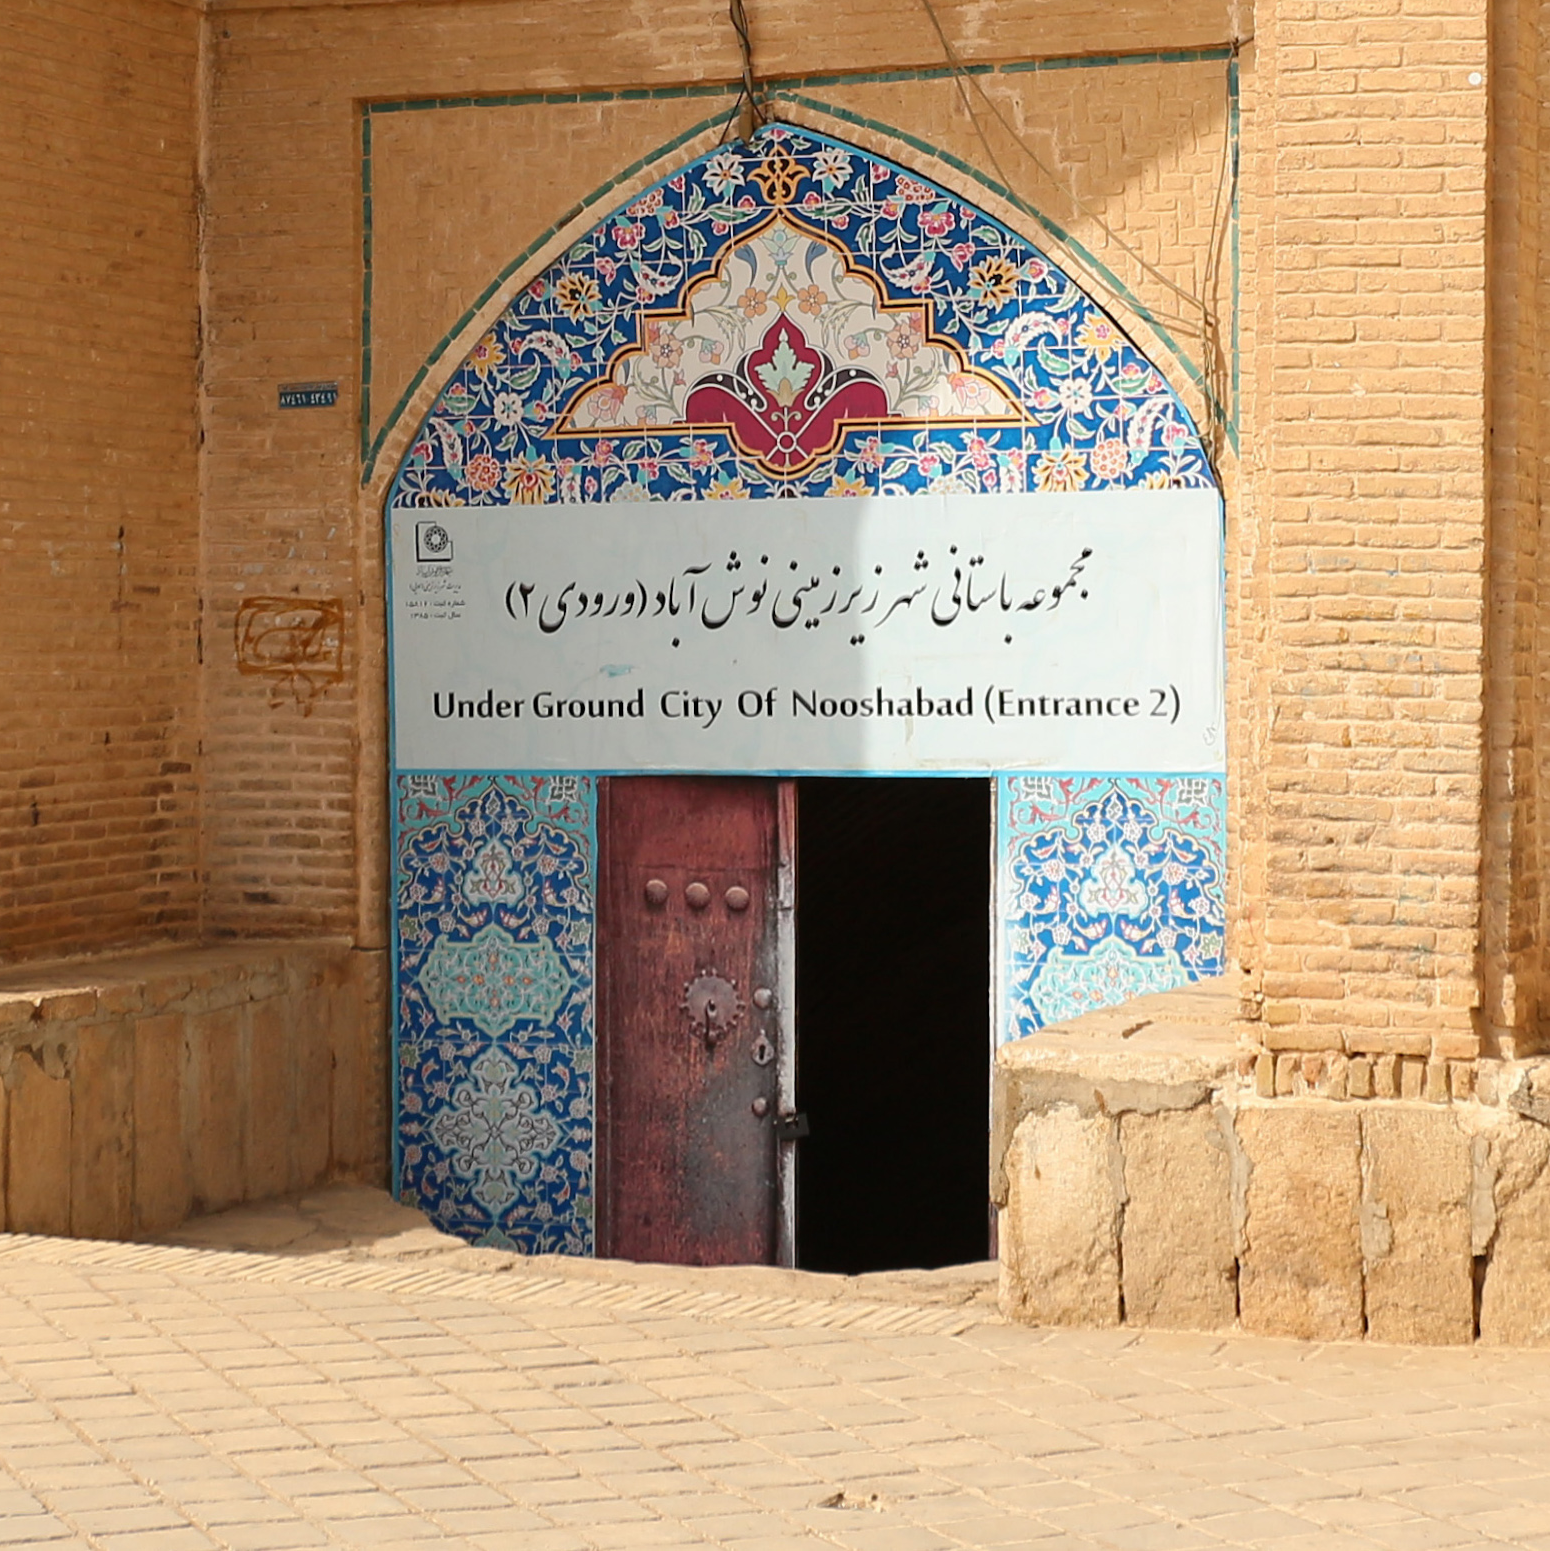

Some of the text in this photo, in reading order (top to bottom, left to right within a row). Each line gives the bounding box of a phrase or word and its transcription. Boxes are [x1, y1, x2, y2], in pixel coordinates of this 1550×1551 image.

[505, 580, 536, 620] ۲)
[538, 579, 648, 634] (ورودی
[652, 562, 713, 648] آباد
[701, 550, 769, 629] نوش
[874, 550, 929, 629] شهر
[931, 545, 1013, 645] باستانی
[1015, 547, 1094, 612] مجموعه
[433, 684, 1181, 729] Under Ground City Of Nooshabad (Entrance 2)
